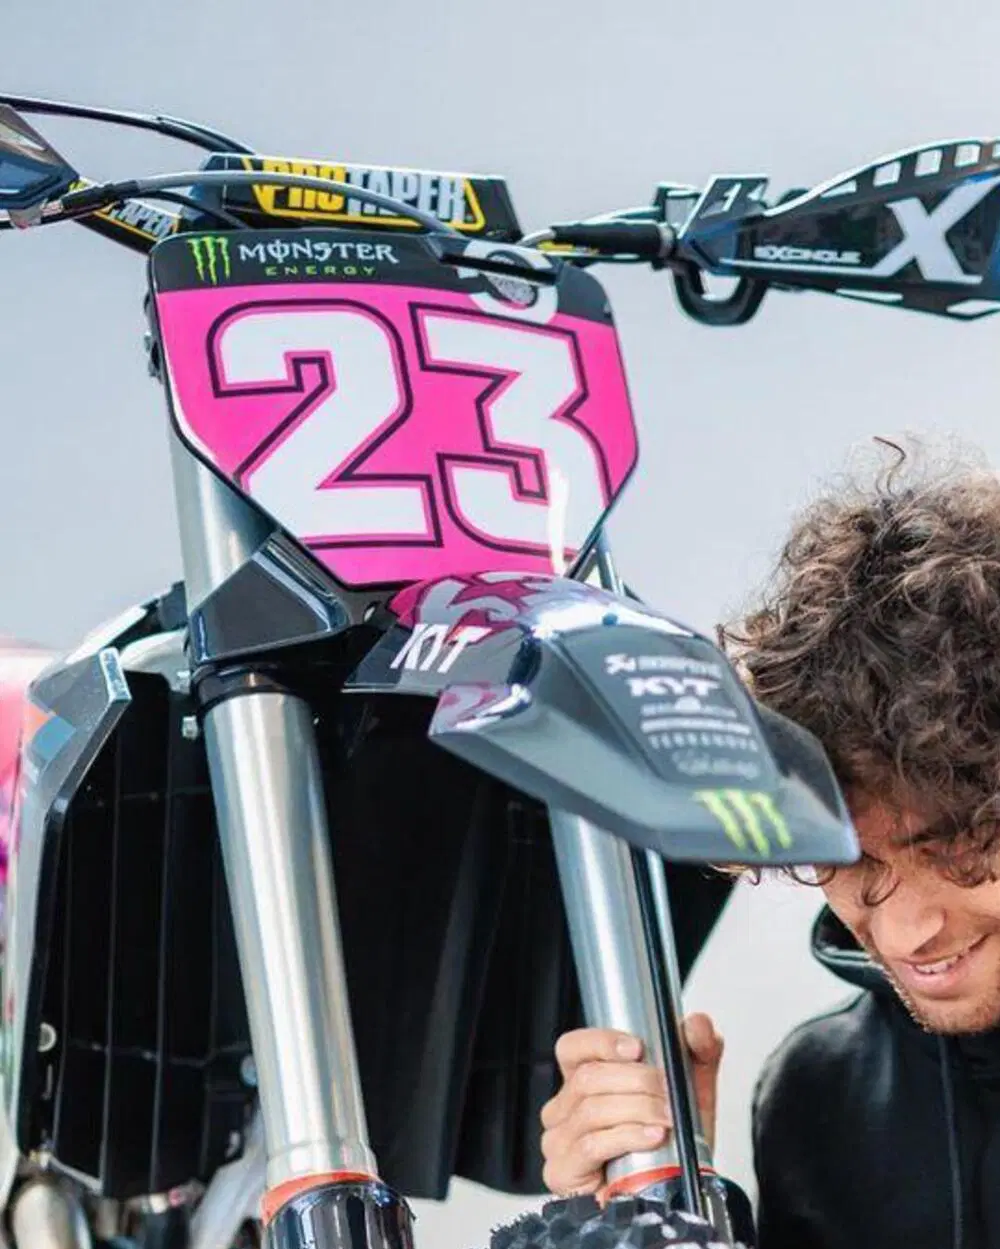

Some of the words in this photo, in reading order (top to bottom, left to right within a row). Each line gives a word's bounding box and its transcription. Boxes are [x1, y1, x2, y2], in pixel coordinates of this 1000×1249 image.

[264, 265, 377, 277] ENERGY
[206, 298, 612, 562] 23
[389, 623, 493, 674] KYT
[626, 675, 721, 698] KYT
